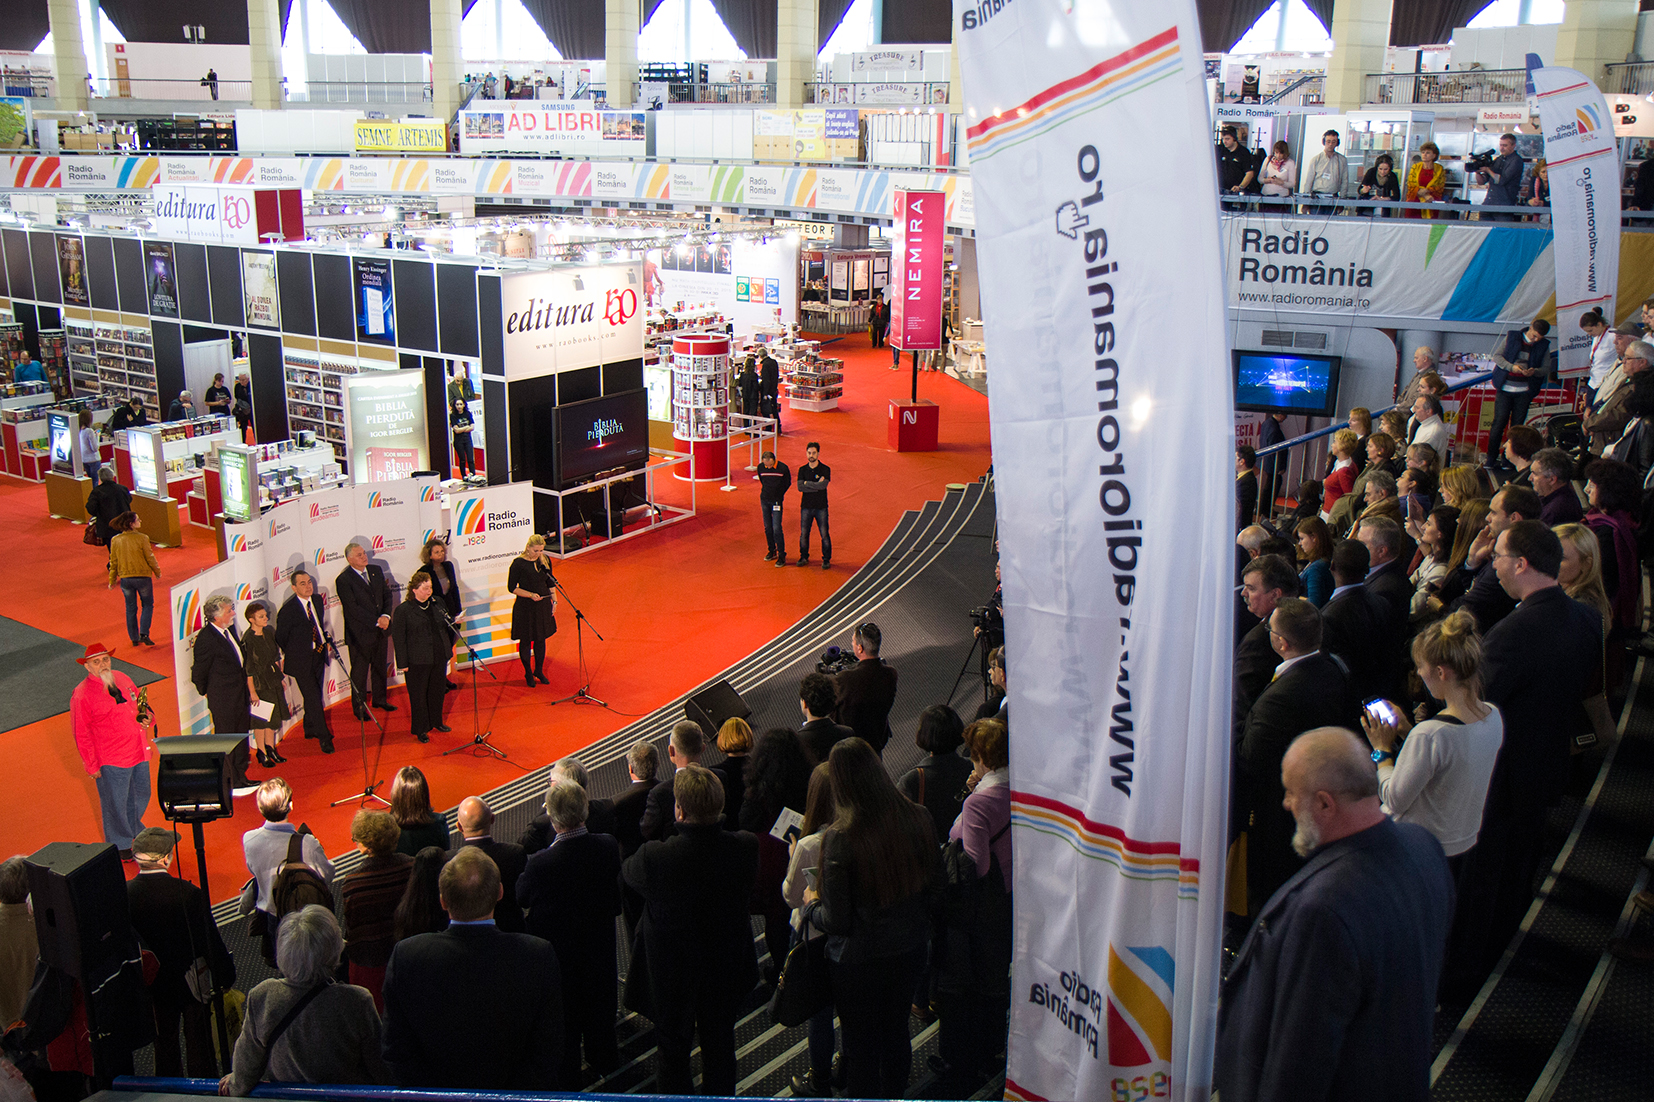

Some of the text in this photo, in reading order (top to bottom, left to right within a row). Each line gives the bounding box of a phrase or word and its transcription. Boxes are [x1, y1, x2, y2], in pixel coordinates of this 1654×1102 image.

[869, 51, 905, 63] TREASURE
[871, 83, 908, 95] TREASURE
[541, 103, 576, 111] SAMSUNG
[1217, 108, 1242, 117] Radio
[1482, 110, 1522, 120] Radio România
[507, 112, 601, 132] AD LIBRI
[357, 127, 444, 147] SEMNE ARTEMIS
[523, 133, 586, 141] www.adlibri.ro
[68, 164, 93, 173] Radio
[167, 162, 186, 170] Radio
[260, 166, 283, 174] Radio
[517, 165, 536, 173] Radio
[68, 172, 107, 181] România
[167, 168, 196, 176] România
[349, 170, 378, 178] România
[434, 168, 456, 177] Radio
[517, 172, 544, 180] România
[597, 171, 617, 180] Radio
[260, 174, 295, 182] România
[435, 176, 467, 184] România
[517, 179, 541, 187] Muzical
[749, 176, 768, 186] Radio
[821, 177, 836, 185] Radio
[597, 179, 627, 189] România
[821, 184, 842, 193] România
[749, 185, 777, 195] România
[156, 191, 217, 221] editura
[1241, 227, 1330, 257] Radio
[907, 198, 924, 301] NEMIRA
[361, 272, 382, 281] Ordinea
[1238, 257, 1374, 288] România
[1237, 292, 1371, 308] www.radioromania.ro
[506, 297, 595, 335] editura
[535, 330, 617, 351] www.raobooks.com
[374, 400, 408, 413] BIBLIA
[365, 408, 416, 425] PIERDUTĂ
[388, 422, 398, 430] DE
[593, 418, 618, 432] BIBLIA
[1235, 422, 1254, 437] ECTĂ
[369, 426, 414, 438] IGOR BERGLER
[587, 422, 624, 441] PIERDUTĂ
[384, 459, 414, 473] BIBLIA
[382, 499, 404, 507] România
[309, 511, 340, 525] gaudeamus
[488, 510, 517, 522] Radio
[488, 517, 531, 532] România
[247, 538, 260, 546] Radio
[325, 554, 345, 563] România
[252, 586, 265, 595] Radio
